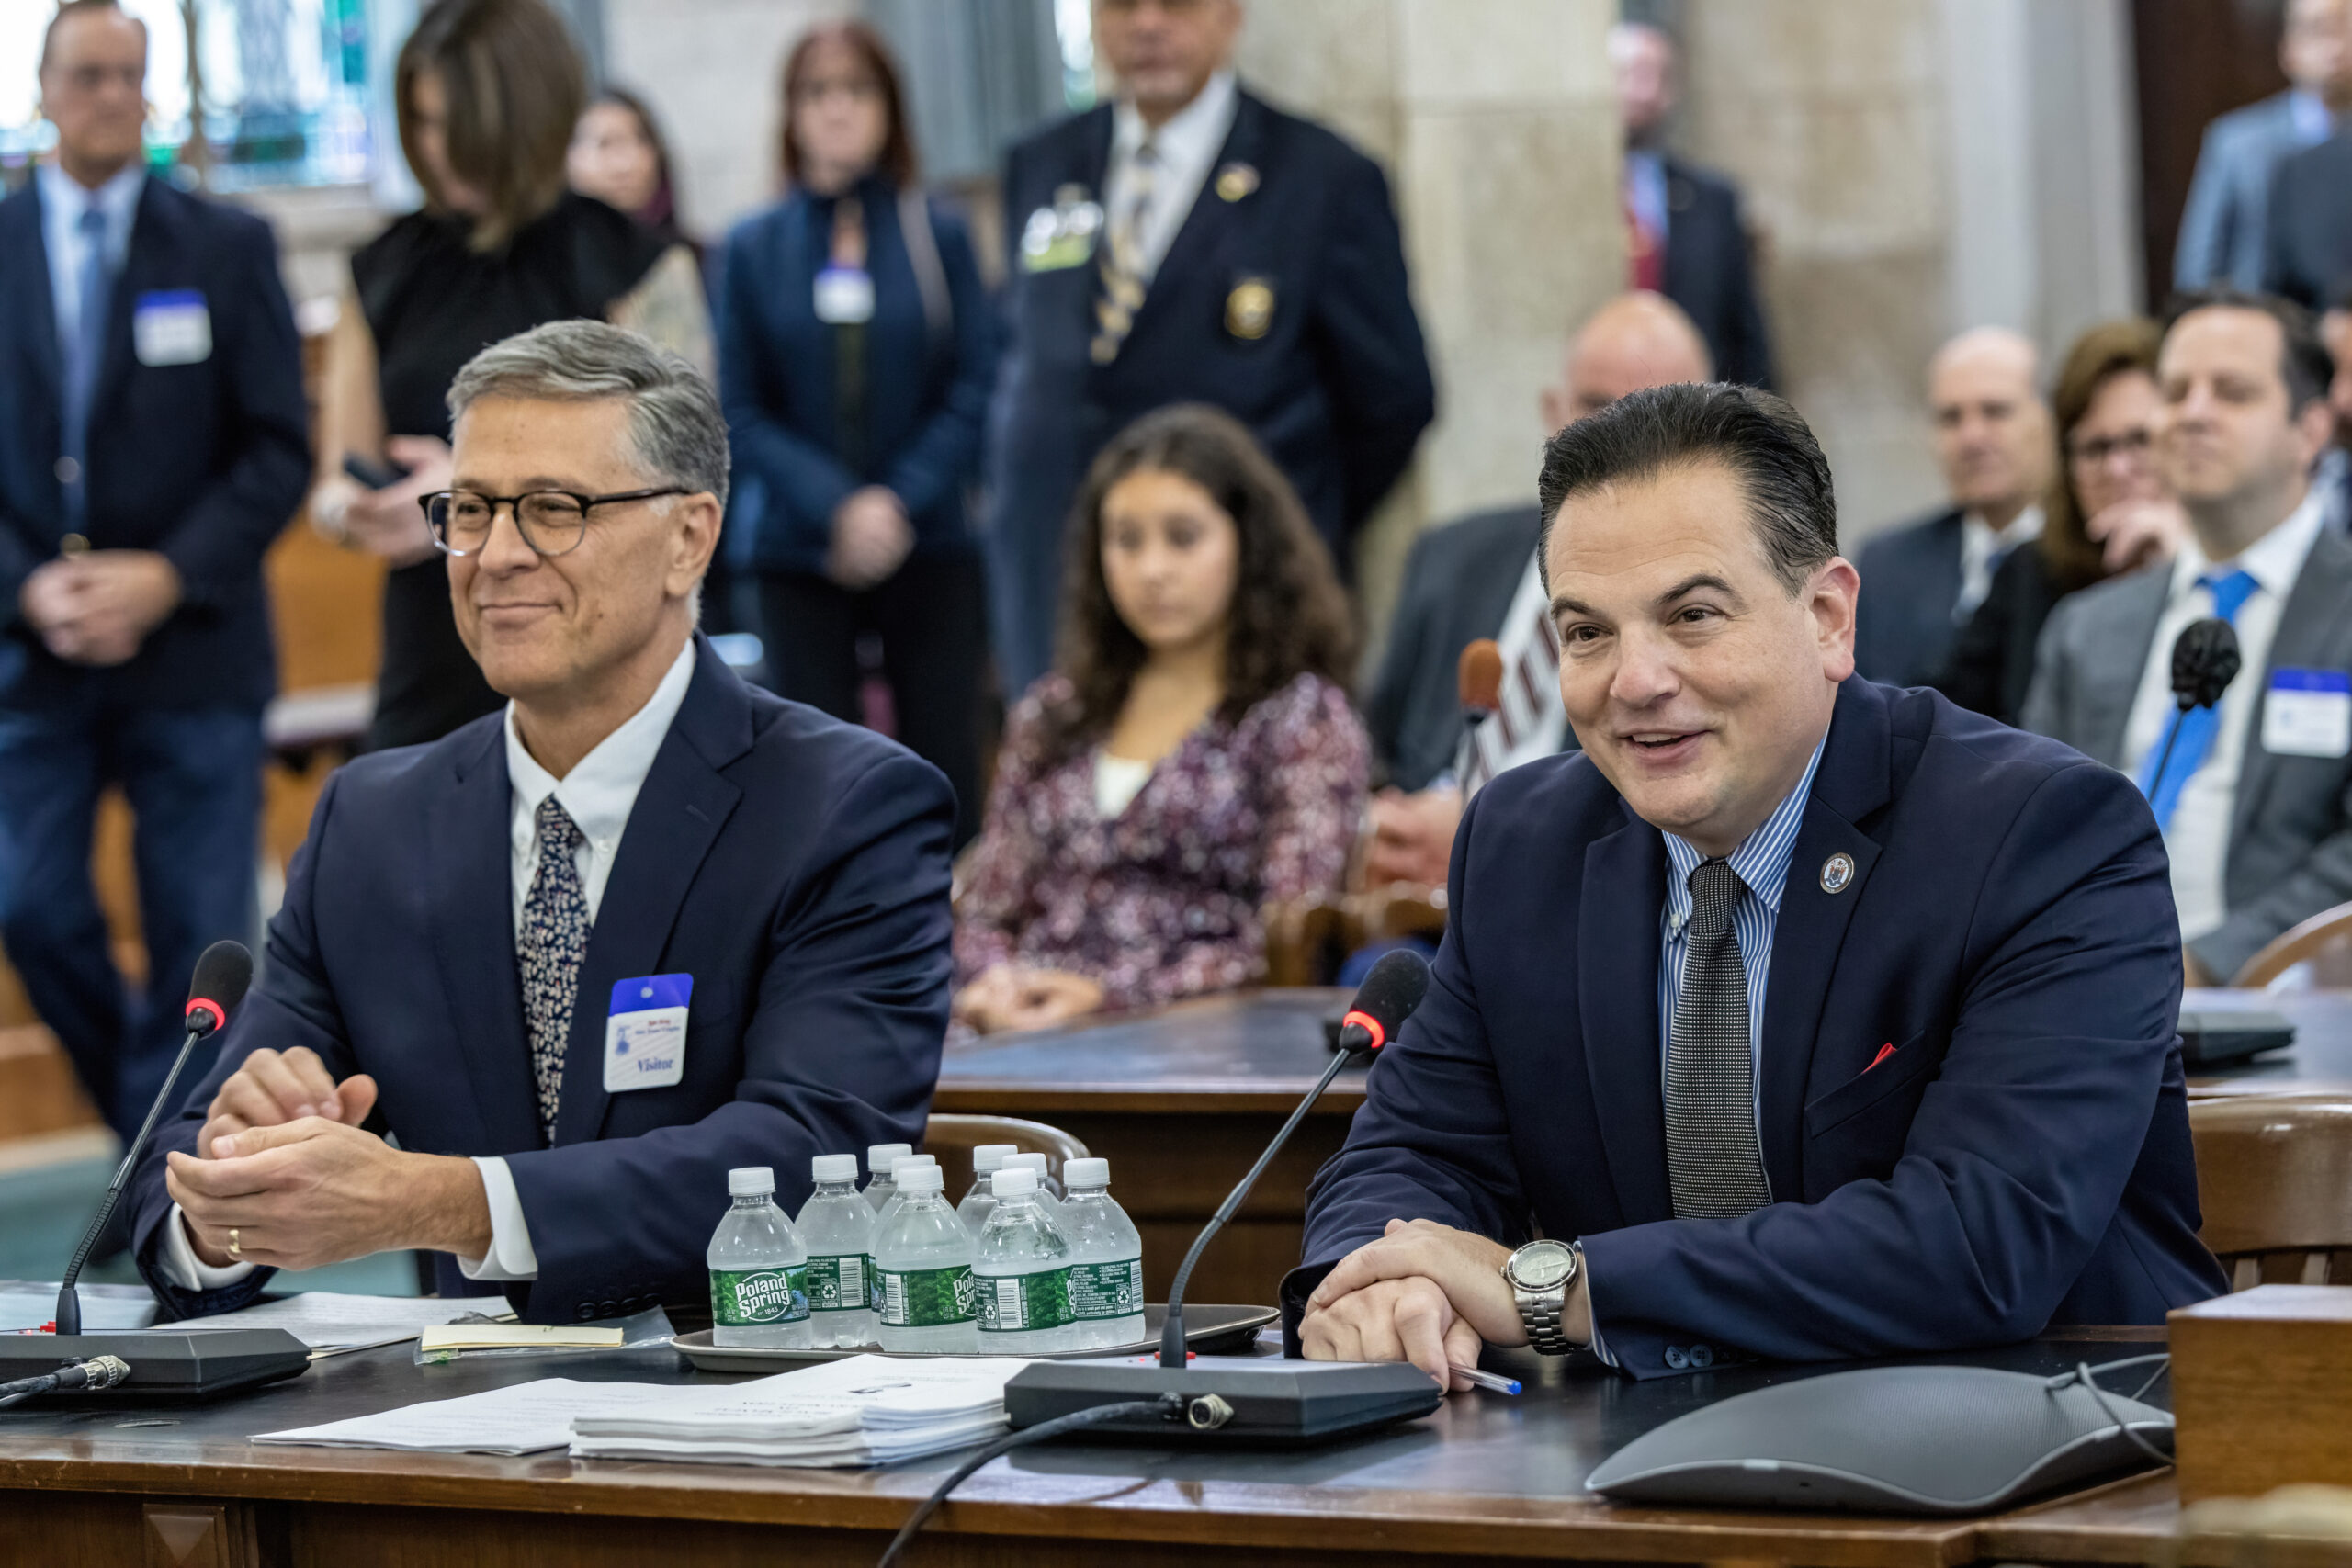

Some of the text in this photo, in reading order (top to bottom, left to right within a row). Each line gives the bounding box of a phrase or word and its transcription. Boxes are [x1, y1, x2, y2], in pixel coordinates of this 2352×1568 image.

[638, 1056, 673, 1072] Visitor
[735, 1271, 788, 1301] Poland
[953, 1275, 974, 1298] Pol
[738, 1289, 791, 1318] Spring
[764, 1306, 779, 1315] 1845
[956, 1289, 975, 1314] Spr
